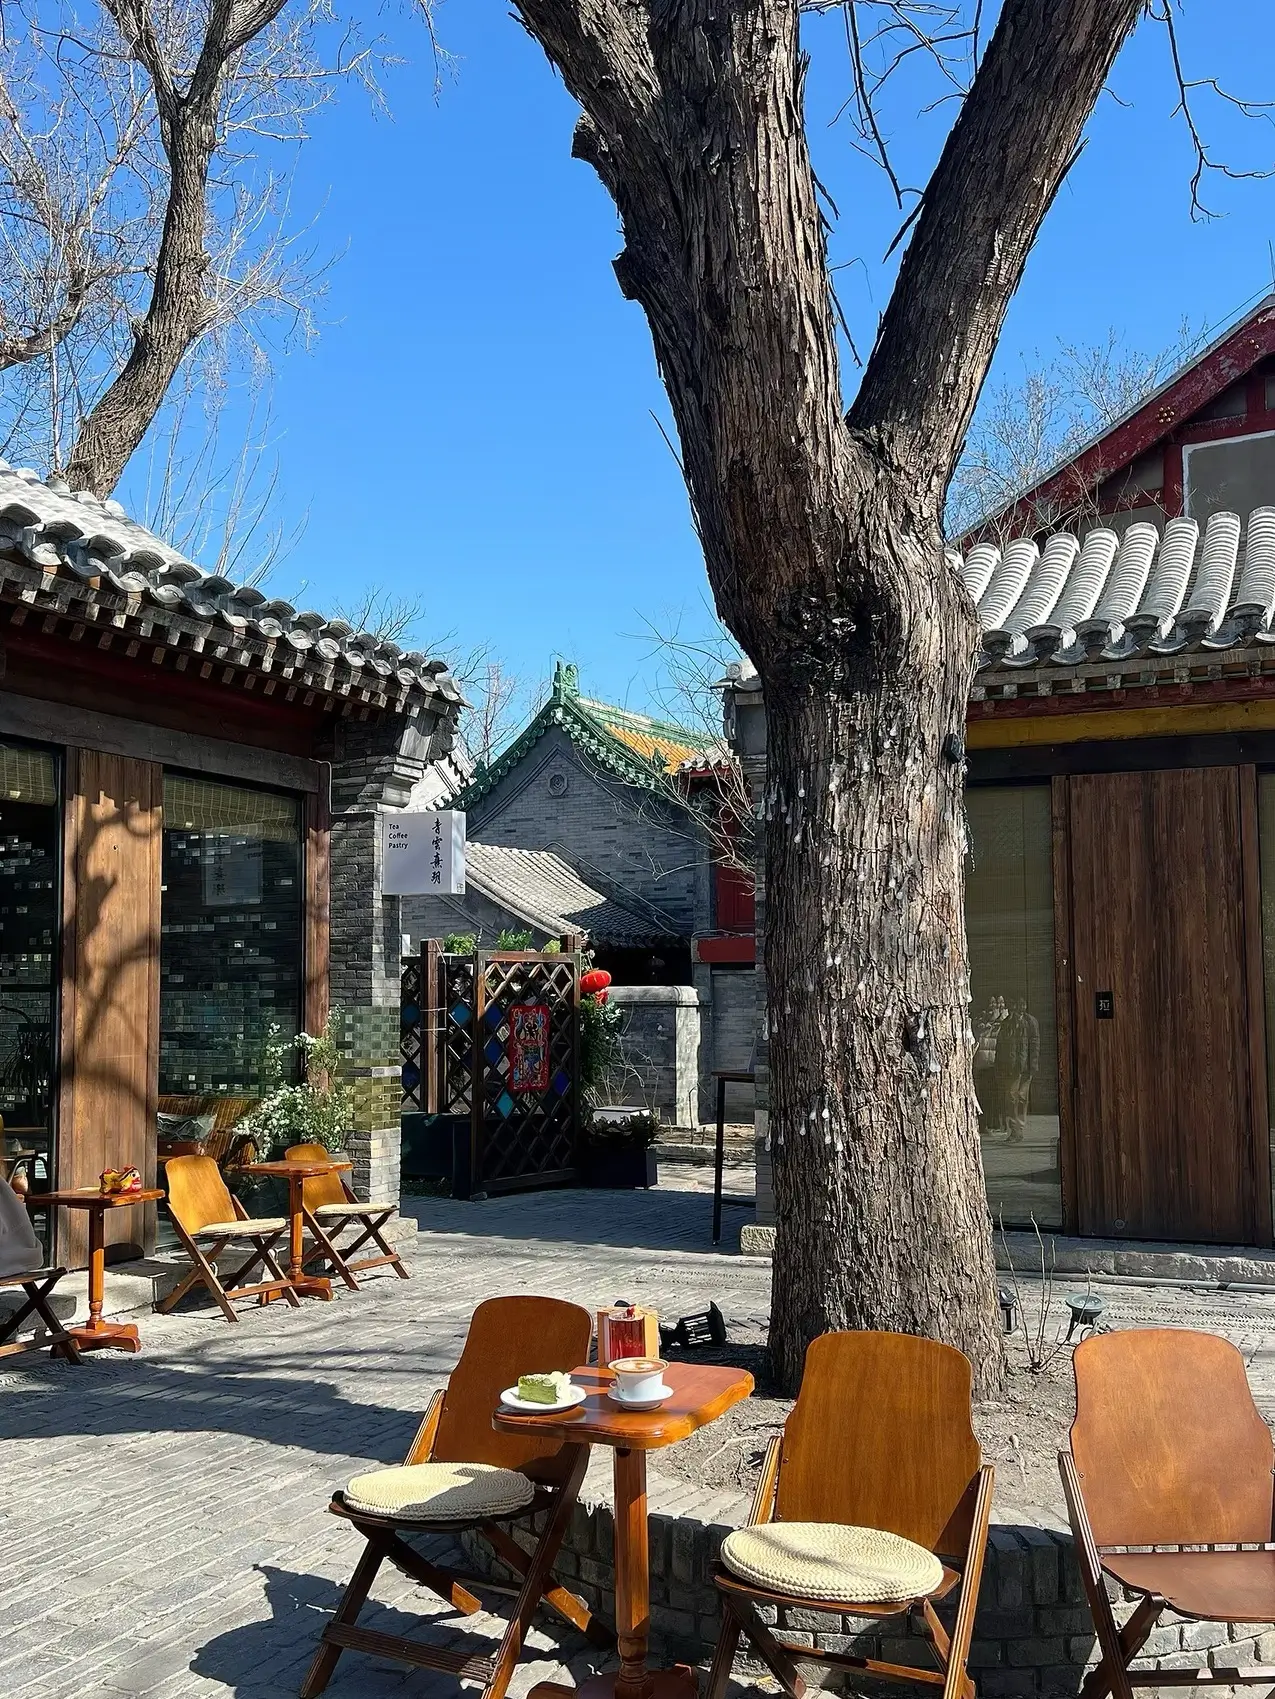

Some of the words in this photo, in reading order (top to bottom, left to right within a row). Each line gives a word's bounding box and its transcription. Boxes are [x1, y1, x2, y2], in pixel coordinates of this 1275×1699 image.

[388, 832, 408, 840] Coffee
[388, 842, 408, 850] Pastry
[1099, 999, 1110, 1011] 拉
